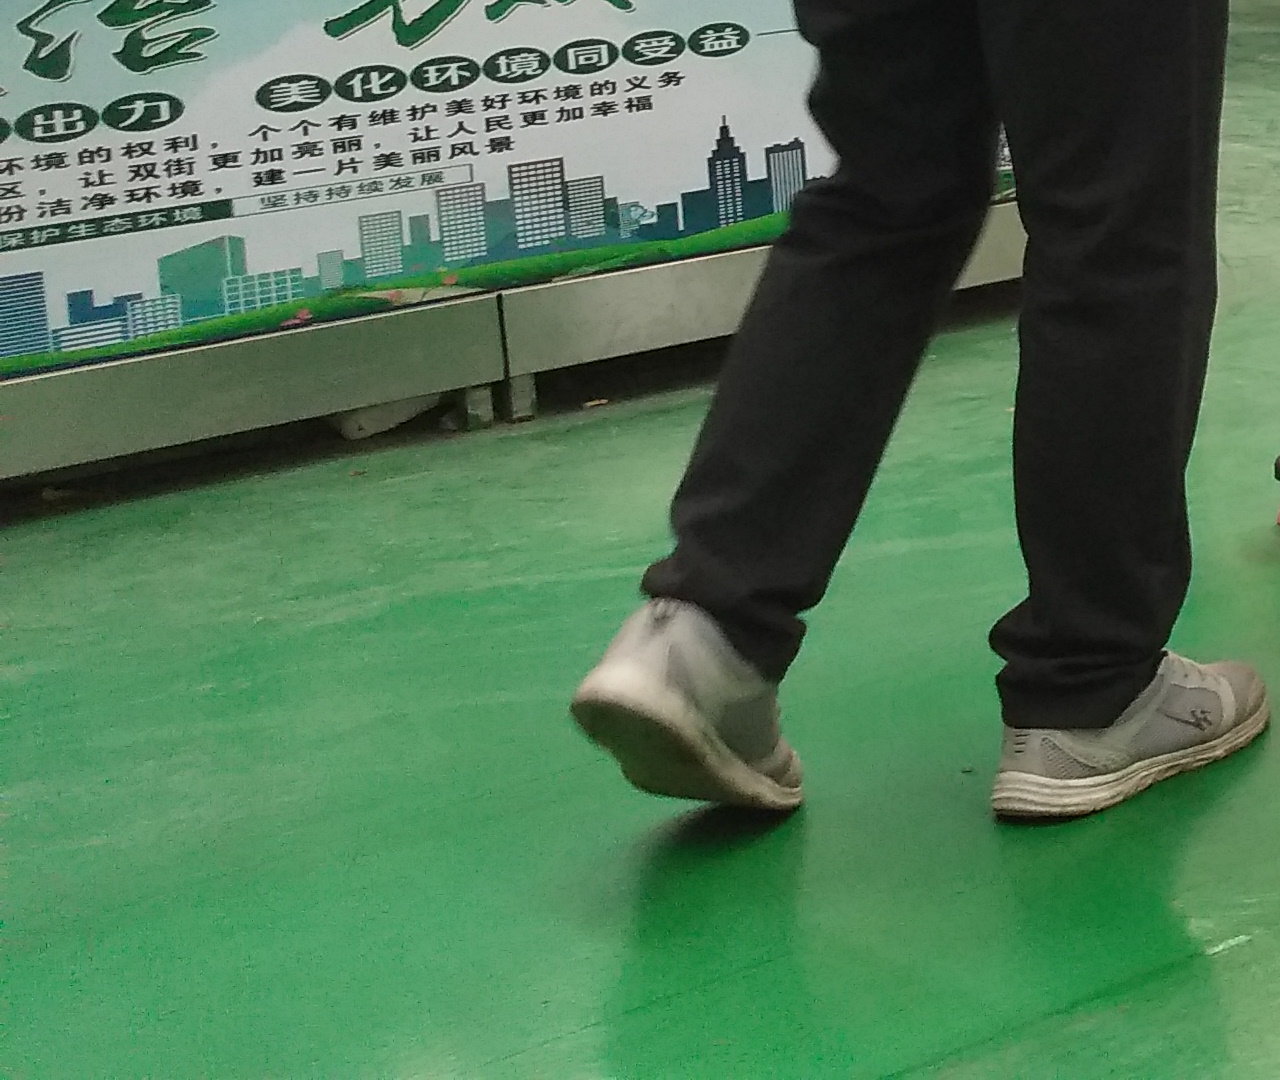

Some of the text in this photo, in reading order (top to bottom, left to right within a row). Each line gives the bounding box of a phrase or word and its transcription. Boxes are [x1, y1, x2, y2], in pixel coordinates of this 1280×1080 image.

[260, 24, 747, 111] 美化环境同受益
[23, 94, 181, 141] 出力
